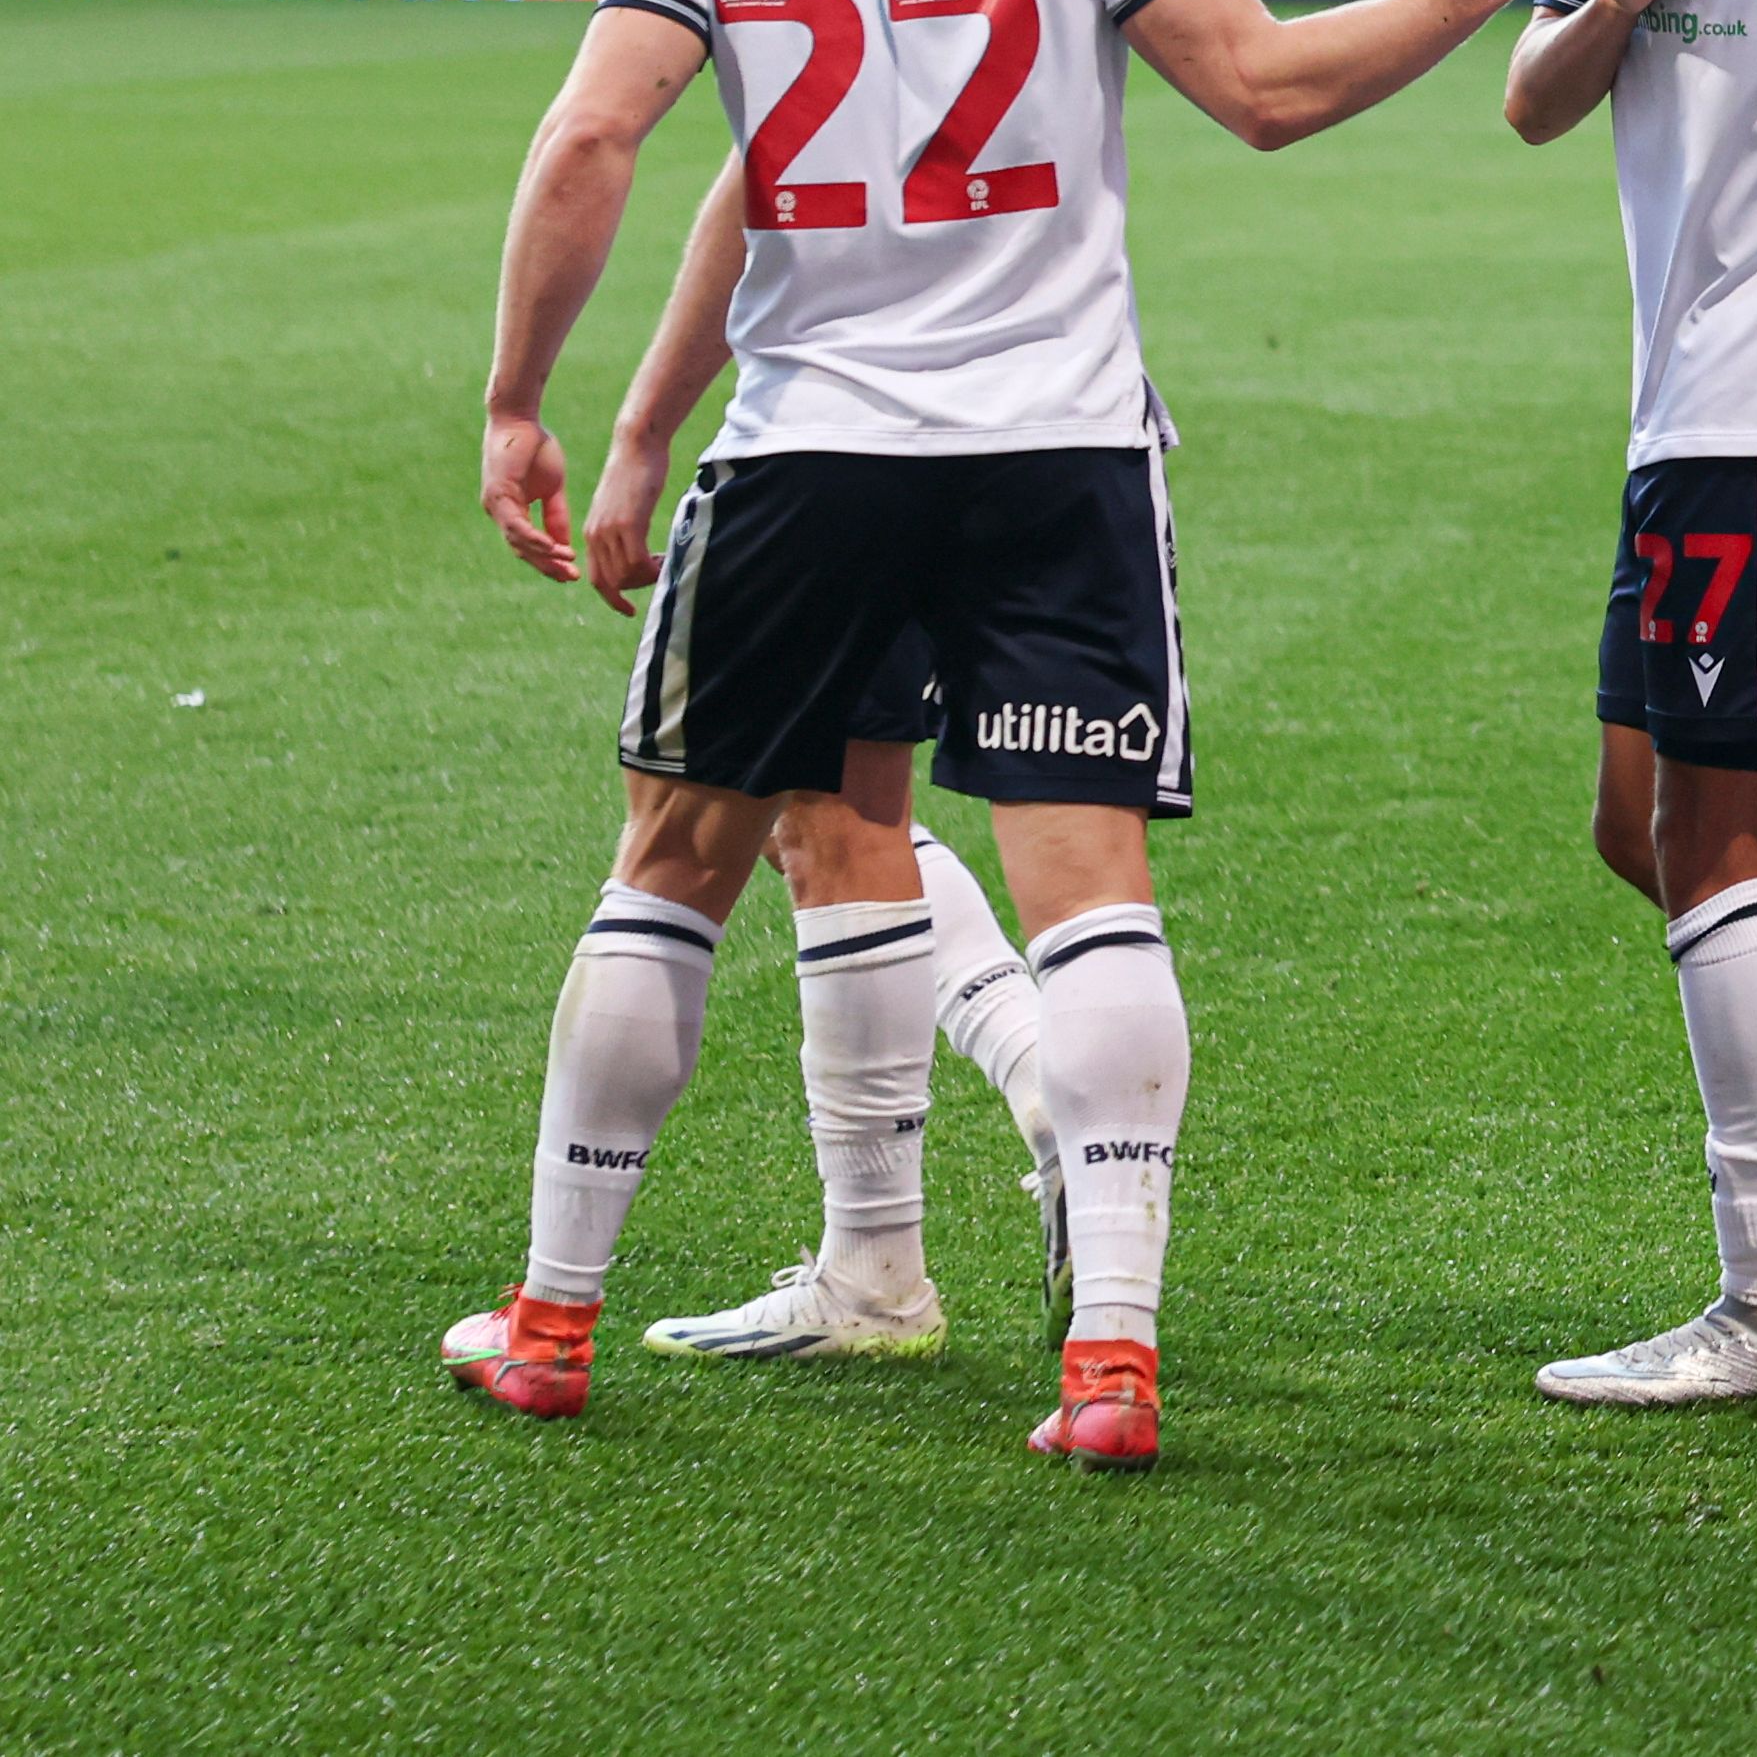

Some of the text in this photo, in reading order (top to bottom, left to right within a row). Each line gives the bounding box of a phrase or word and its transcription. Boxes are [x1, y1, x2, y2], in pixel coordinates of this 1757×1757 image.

[1635, 533, 1753, 645] 27
[977, 702, 1116, 758] utilita
[1083, 1140, 1174, 1170] BWFC
